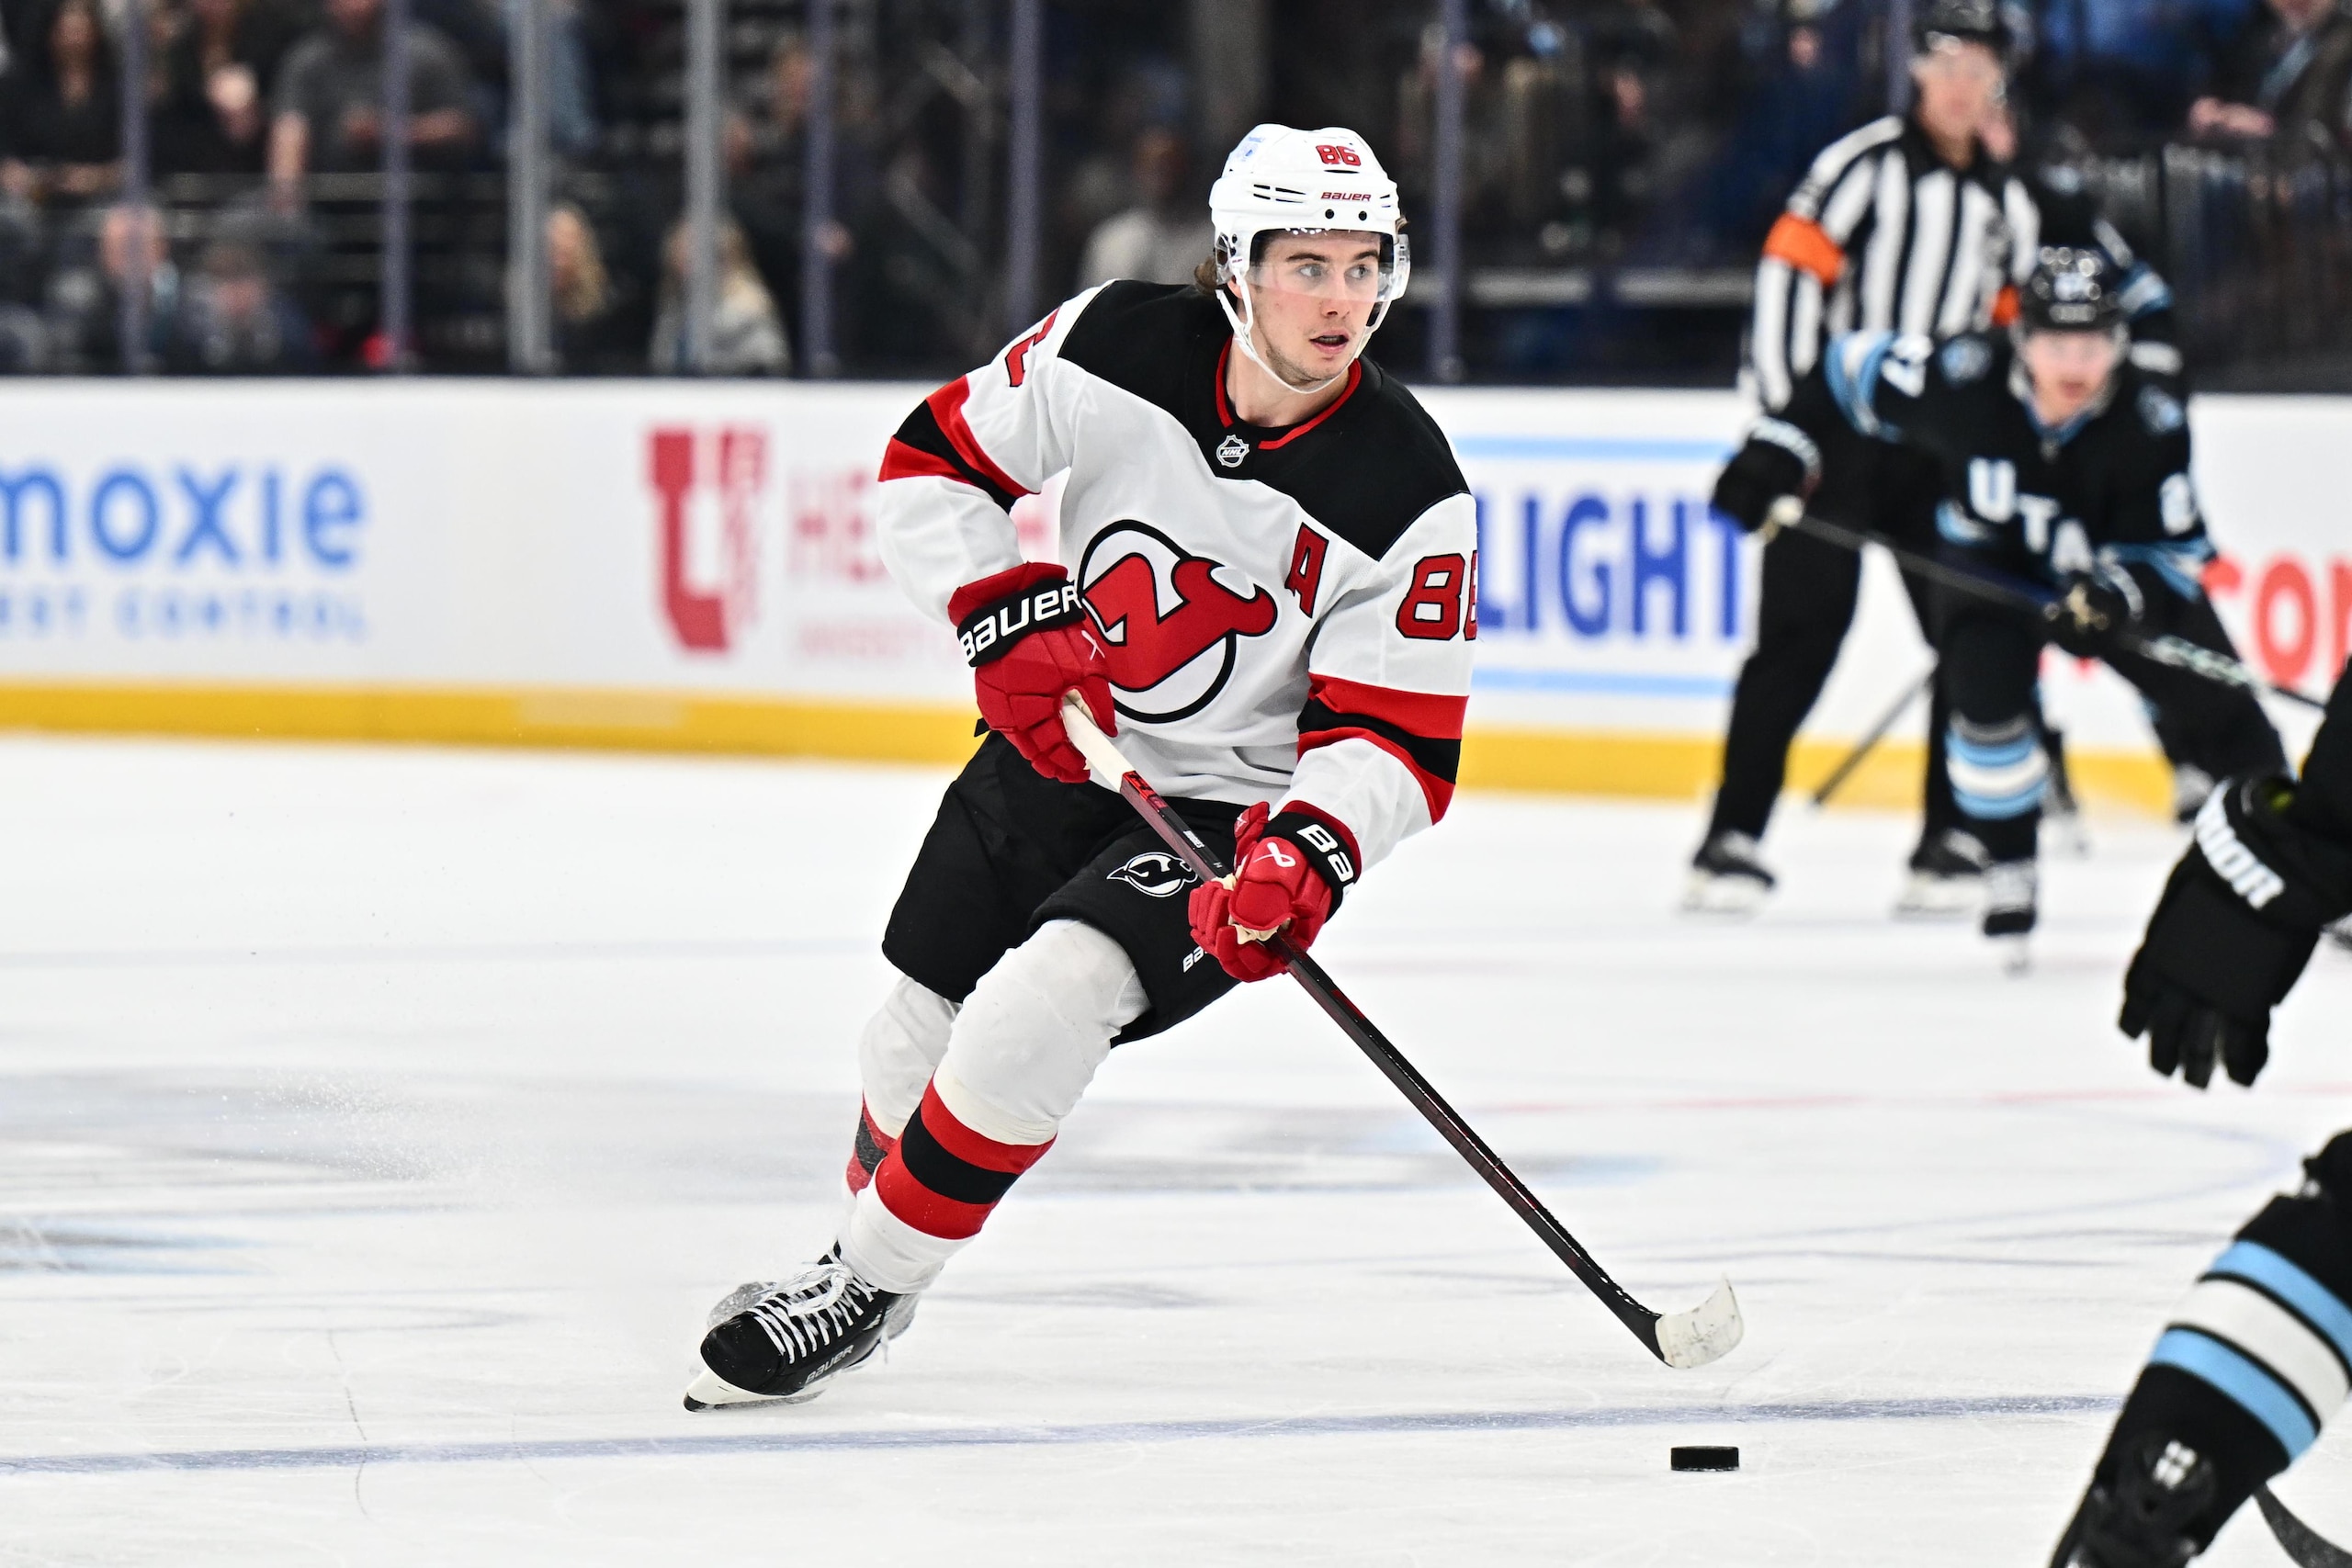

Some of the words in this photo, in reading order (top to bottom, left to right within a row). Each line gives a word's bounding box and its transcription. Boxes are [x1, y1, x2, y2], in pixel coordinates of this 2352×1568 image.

[1315, 143, 1363, 167] 86
[1320, 191, 1372, 203] BAUER
[1967, 458, 2097, 577] UTA
[1284, 521, 1330, 619] A
[1395, 549, 1478, 641] 8
[1476, 496, 1739, 638] LIGHT
[959, 584, 1084, 665] BAUER
[1296, 823, 1355, 883] BA
[1182, 945, 1208, 974] BA
[804, 1344, 854, 1385] BAUER
